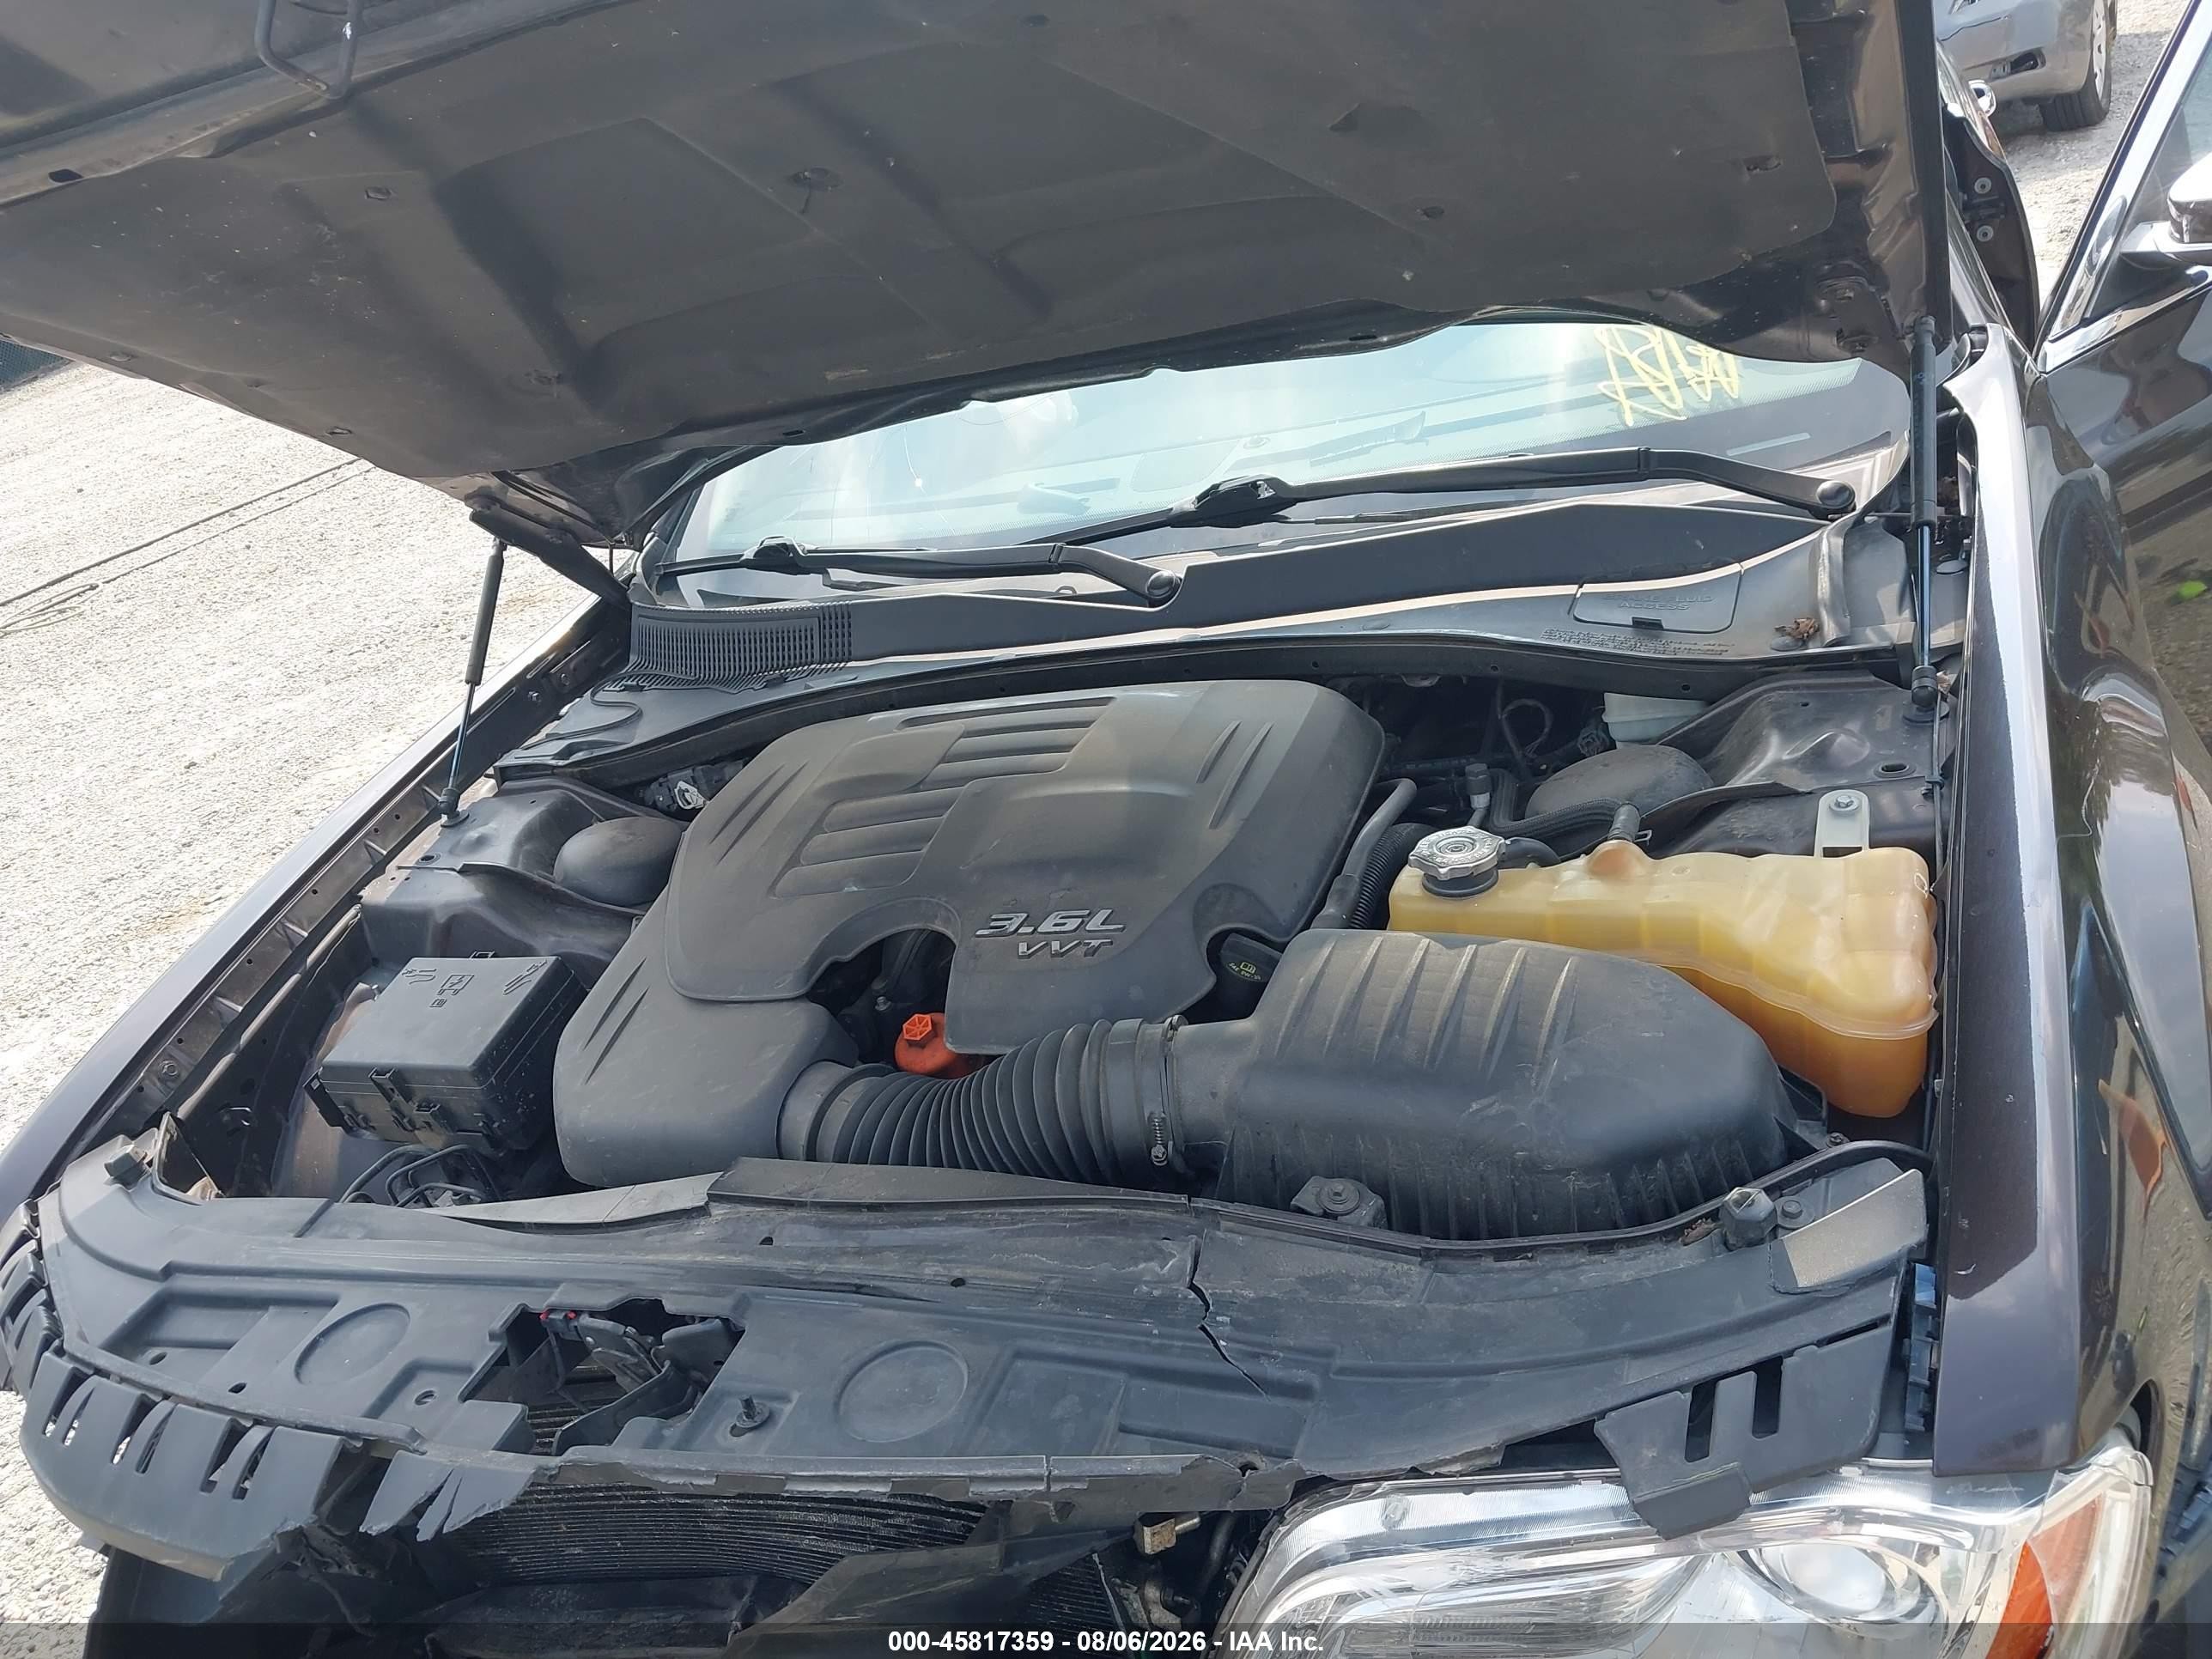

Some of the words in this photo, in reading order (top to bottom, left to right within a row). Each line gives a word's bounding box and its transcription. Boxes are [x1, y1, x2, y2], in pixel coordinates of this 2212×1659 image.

[1619, 601, 1691, 611] ACCESS
[975, 908, 1126, 939] 3.6L
[1017, 939, 1114, 960] VVT
